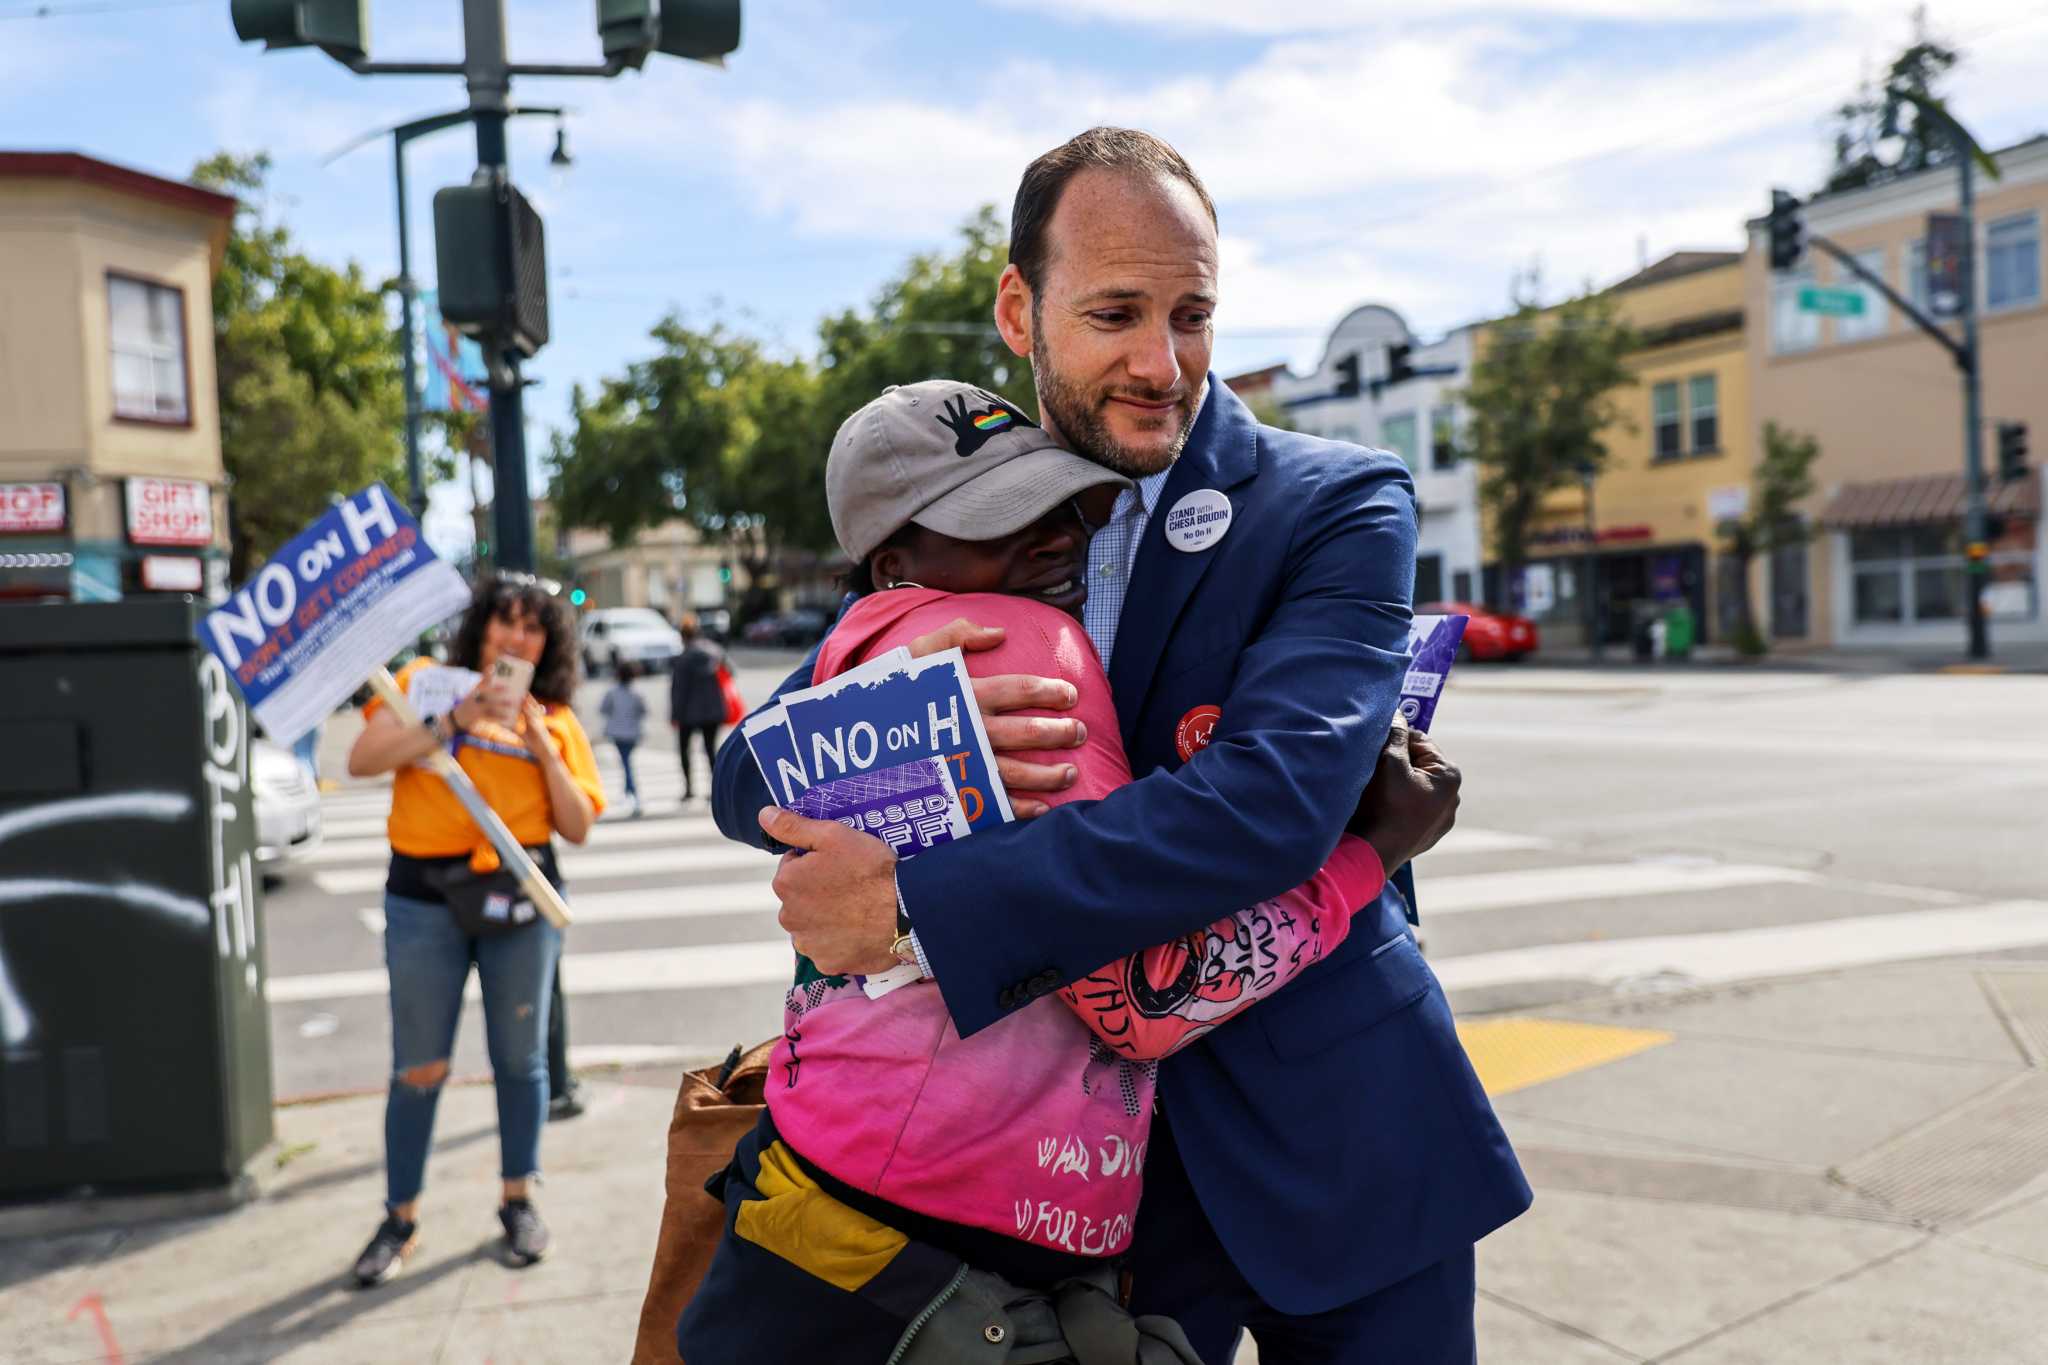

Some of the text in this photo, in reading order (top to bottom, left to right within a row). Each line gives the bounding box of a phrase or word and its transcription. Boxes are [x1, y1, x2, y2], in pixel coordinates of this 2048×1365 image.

[142, 480, 195, 505] GIFT
[1169, 504, 1213, 521] STAND WITH
[1169, 510, 1228, 531] CHESA BOUDIN
[1195, 529, 1205, 538] On
[207, 562, 297, 671] NO
[296, 529, 346, 582] ON
[339, 484, 398, 555] H
[811, 721, 878, 780] NO
[887, 721, 920, 751] ON
[927, 696, 961, 751] H
